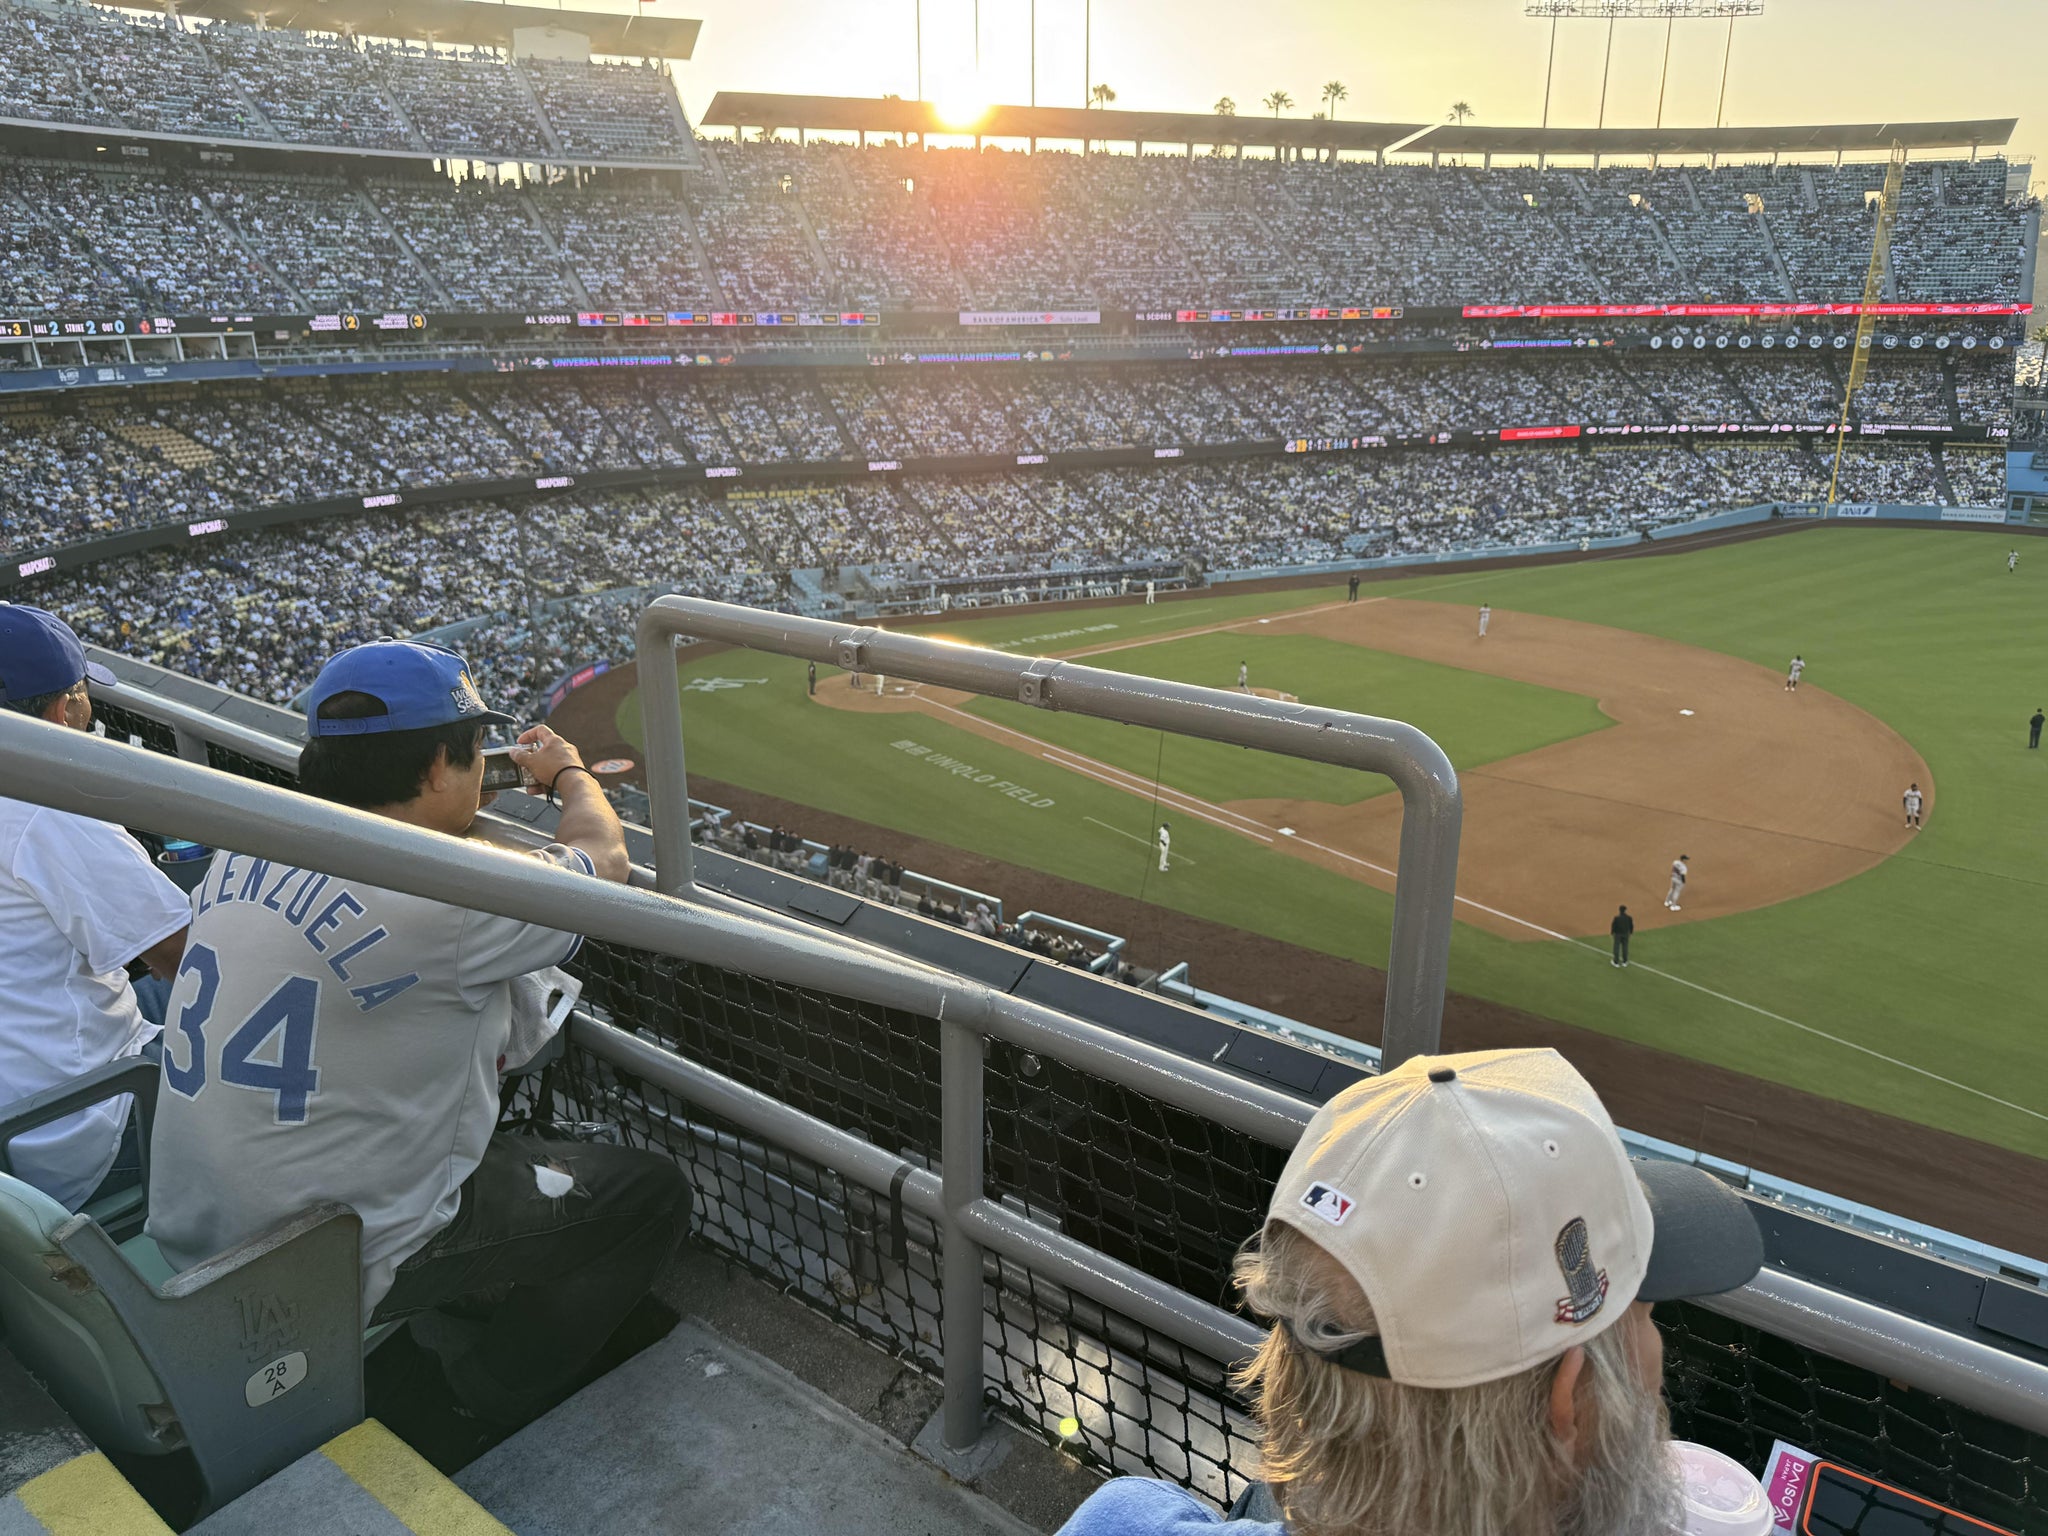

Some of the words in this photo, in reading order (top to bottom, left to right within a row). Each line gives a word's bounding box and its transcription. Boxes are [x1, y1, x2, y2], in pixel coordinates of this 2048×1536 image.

[525, 314, 536, 324] AL
[537, 314, 571, 324] SCORES
[1146, 311, 1172, 321] SCORES
[13, 323, 22, 336] 3
[33, 324, 48, 334] BALL
[49, 321, 60, 335] 2
[65, 323, 85, 333] STRIKE
[85, 320, 97, 335] 2
[101, 323, 113, 332] OUT
[114, 320, 125, 334] 0
[552, 357, 600, 367] UNIVERSAL
[600, 357, 618, 366] FAN
[619, 356, 639, 366] FEST
[640, 355, 672, 366] NIGHTS
[918, 353, 959, 363] UNIVERSAL
[960, 353, 975, 362] FAN
[976, 353, 993, 362] FEST
[1991, 428, 2009, 437] 7:04
[705, 467, 737, 478] SNAPCHAT
[536, 476, 568, 489] SNAPCHAT
[363, 493, 396, 508] SNAPCHAT
[1840, 507, 1862, 515] ANA
[189, 519, 223, 536] SNAPCHAT
[19, 556, 50, 577] SNAPCHAT
[925, 753, 996, 783] UNIQLO
[988, 780, 1055, 808] FIELD
[188, 852, 421, 1015] LENZUELA
[163, 941, 323, 1126] 34
[264, 1362, 287, 1385] 28
[271, 1379, 286, 1396] A
[1780, 1459, 1792, 1482] JAPAN
